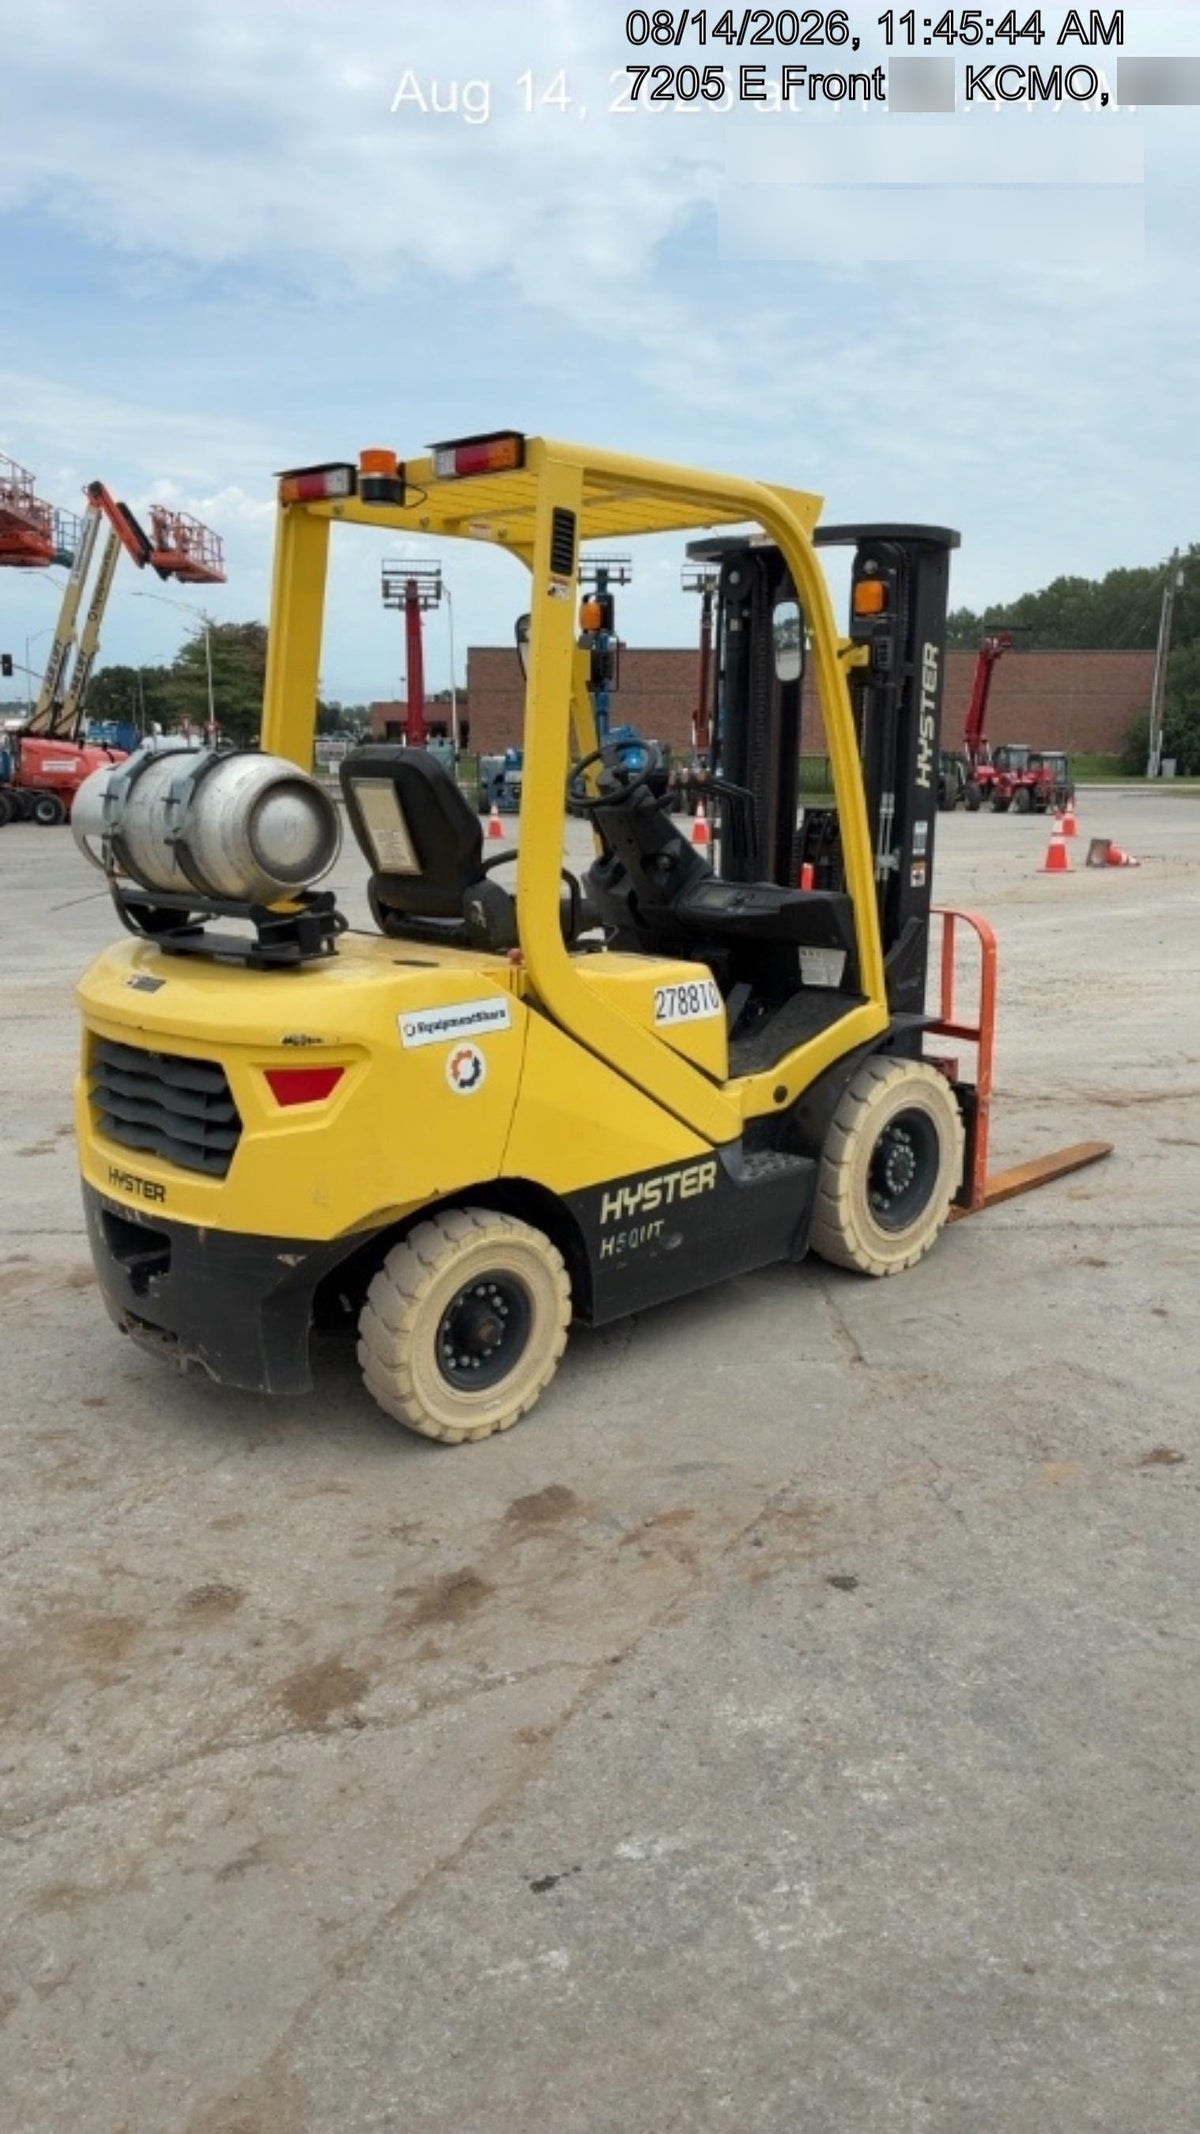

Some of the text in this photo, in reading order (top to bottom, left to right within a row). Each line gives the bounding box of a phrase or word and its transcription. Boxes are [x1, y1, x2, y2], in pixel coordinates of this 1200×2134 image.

[915, 641, 940, 789] HYSTER
[108, 1165, 167, 1203] HYSTER
[600, 1161, 717, 1224] HYSTER
